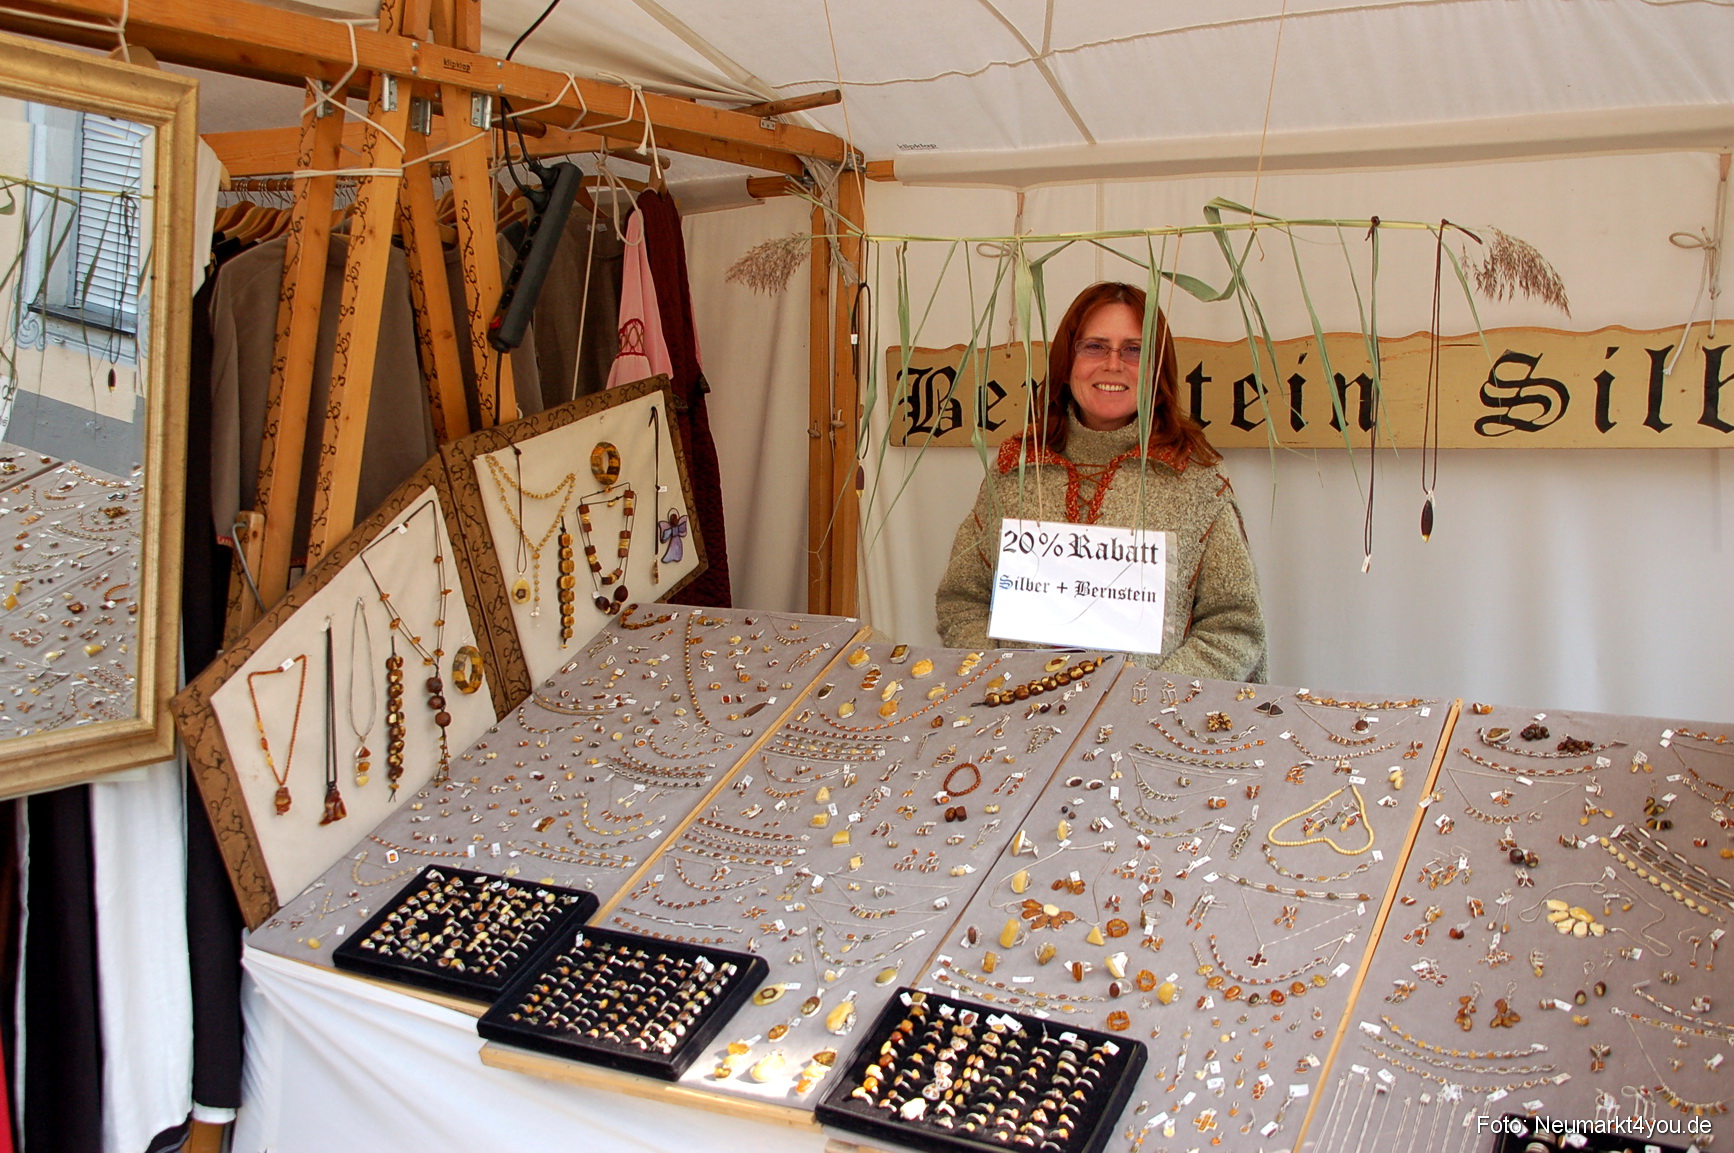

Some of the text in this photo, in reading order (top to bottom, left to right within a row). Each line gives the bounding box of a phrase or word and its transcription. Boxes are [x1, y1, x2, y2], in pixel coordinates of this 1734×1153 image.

[999, 574, 1156, 603] Silber + Bernstein
